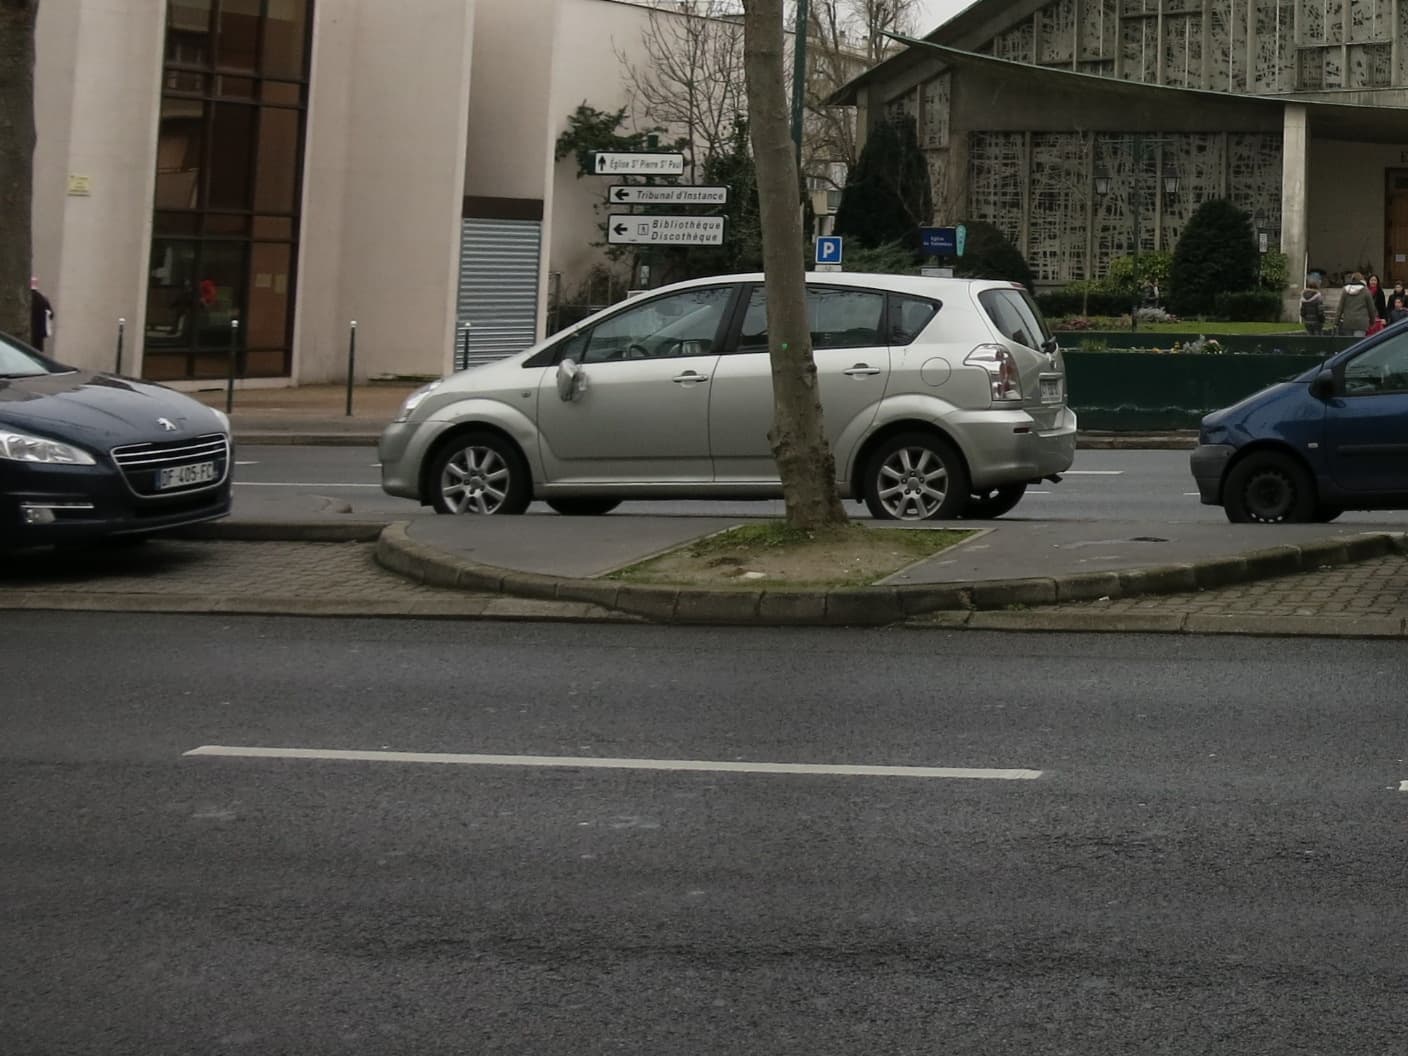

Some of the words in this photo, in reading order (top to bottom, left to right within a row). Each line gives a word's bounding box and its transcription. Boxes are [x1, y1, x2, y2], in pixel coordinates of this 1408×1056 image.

[640, 159, 658, 169] Pierre
[636, 190, 674, 201] Tribunal
[676, 191, 724, 201] d'Instance
[651, 231, 718, 243] Discothèque
[823, 242, 835, 258] P
